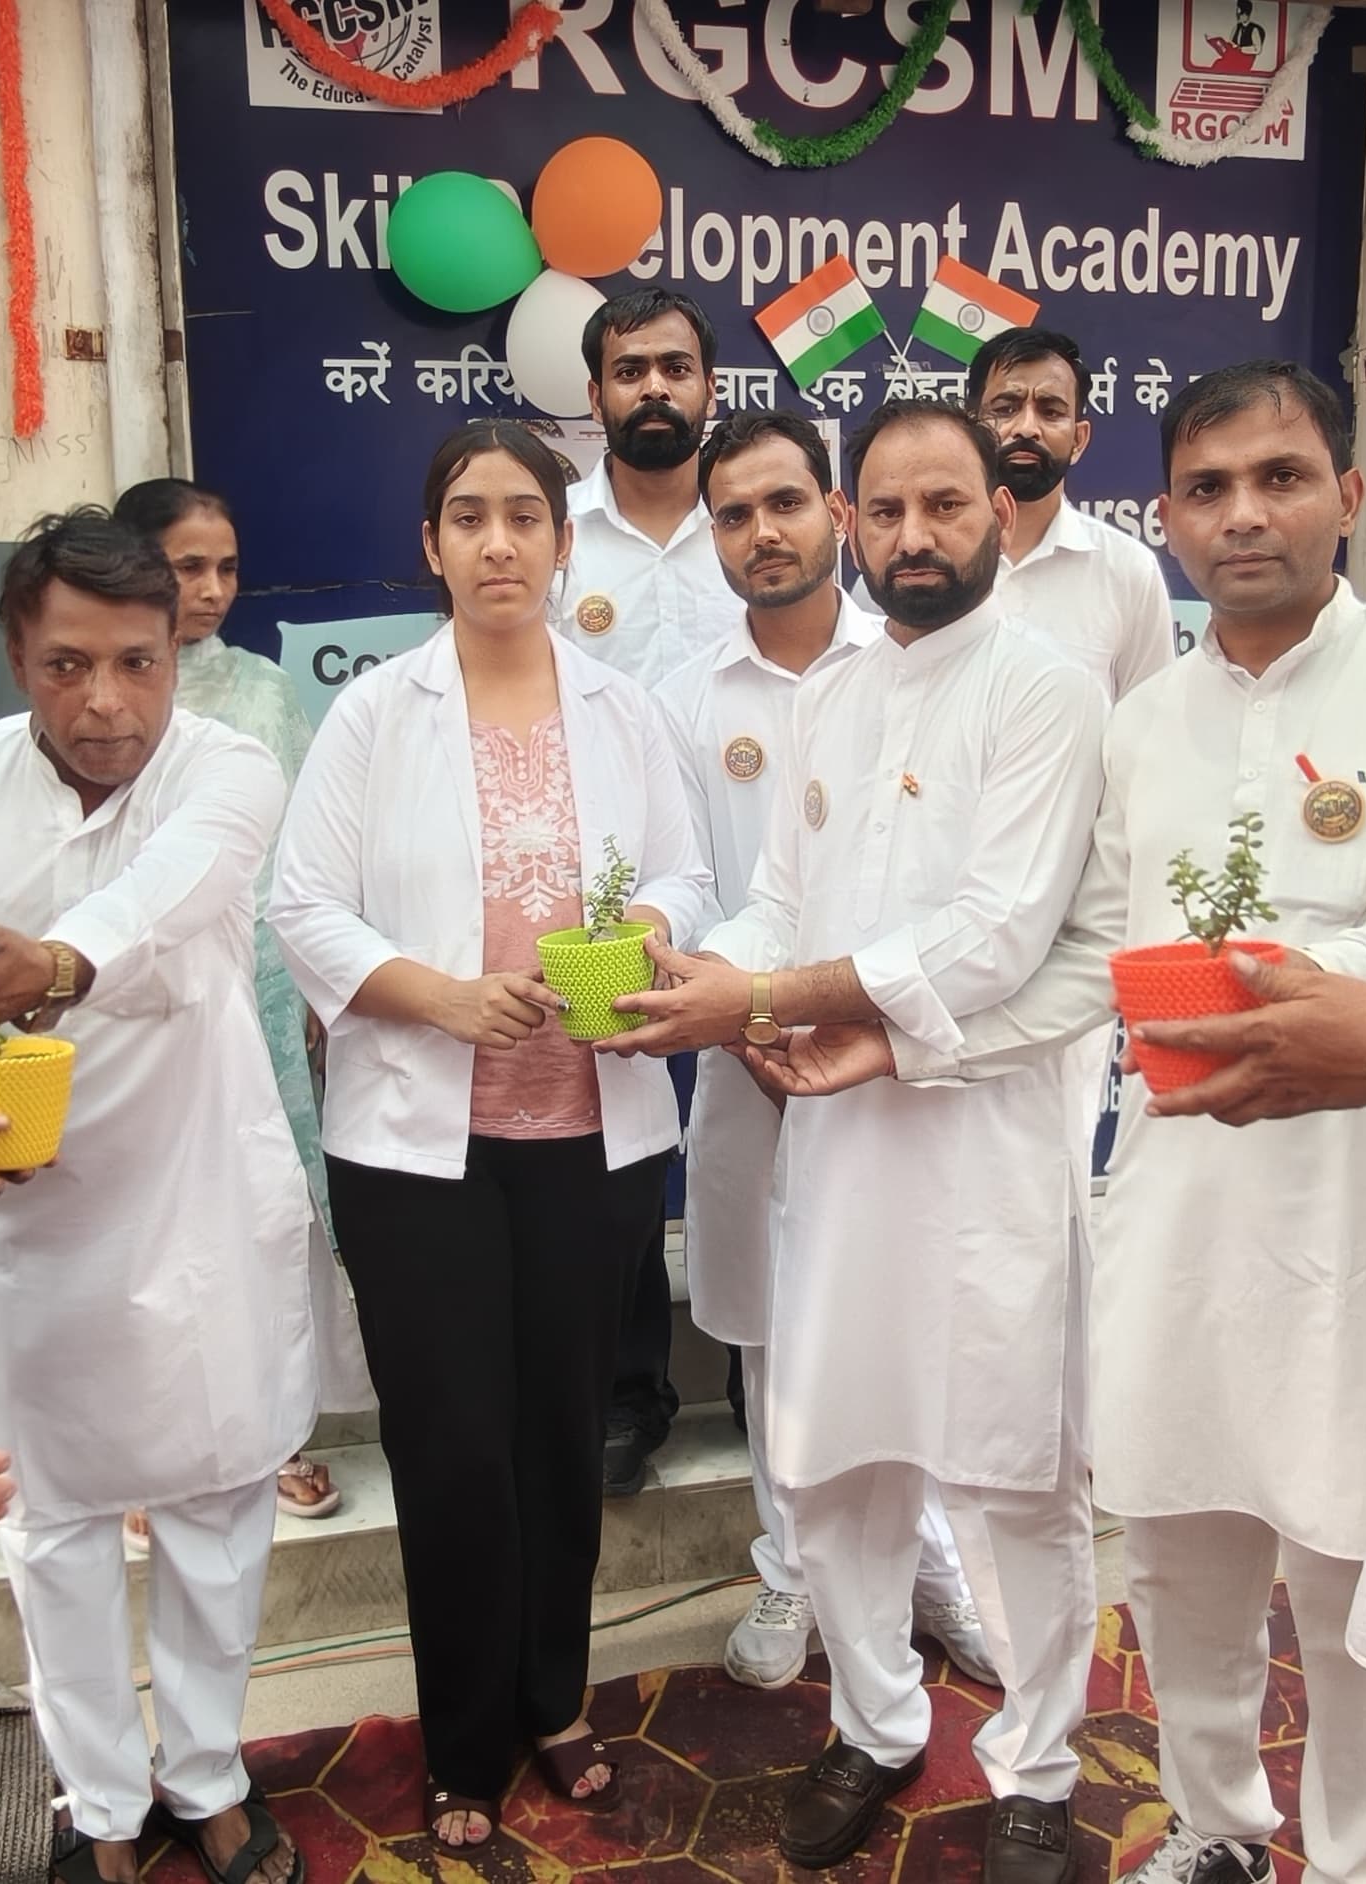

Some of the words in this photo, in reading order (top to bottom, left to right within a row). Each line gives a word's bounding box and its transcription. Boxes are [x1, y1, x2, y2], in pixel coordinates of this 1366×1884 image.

[279, 58, 308, 91] The
[392, 16, 433, 82] Catalyst
[509, 0, 1100, 121] RGCSM
[1171, 111, 1290, 146] RGCM
[988, 201, 1301, 322] Academy
[322, 341, 392, 404] करें
[414, 343, 524, 406] करिय
[1134, 358, 1172, 415] के
